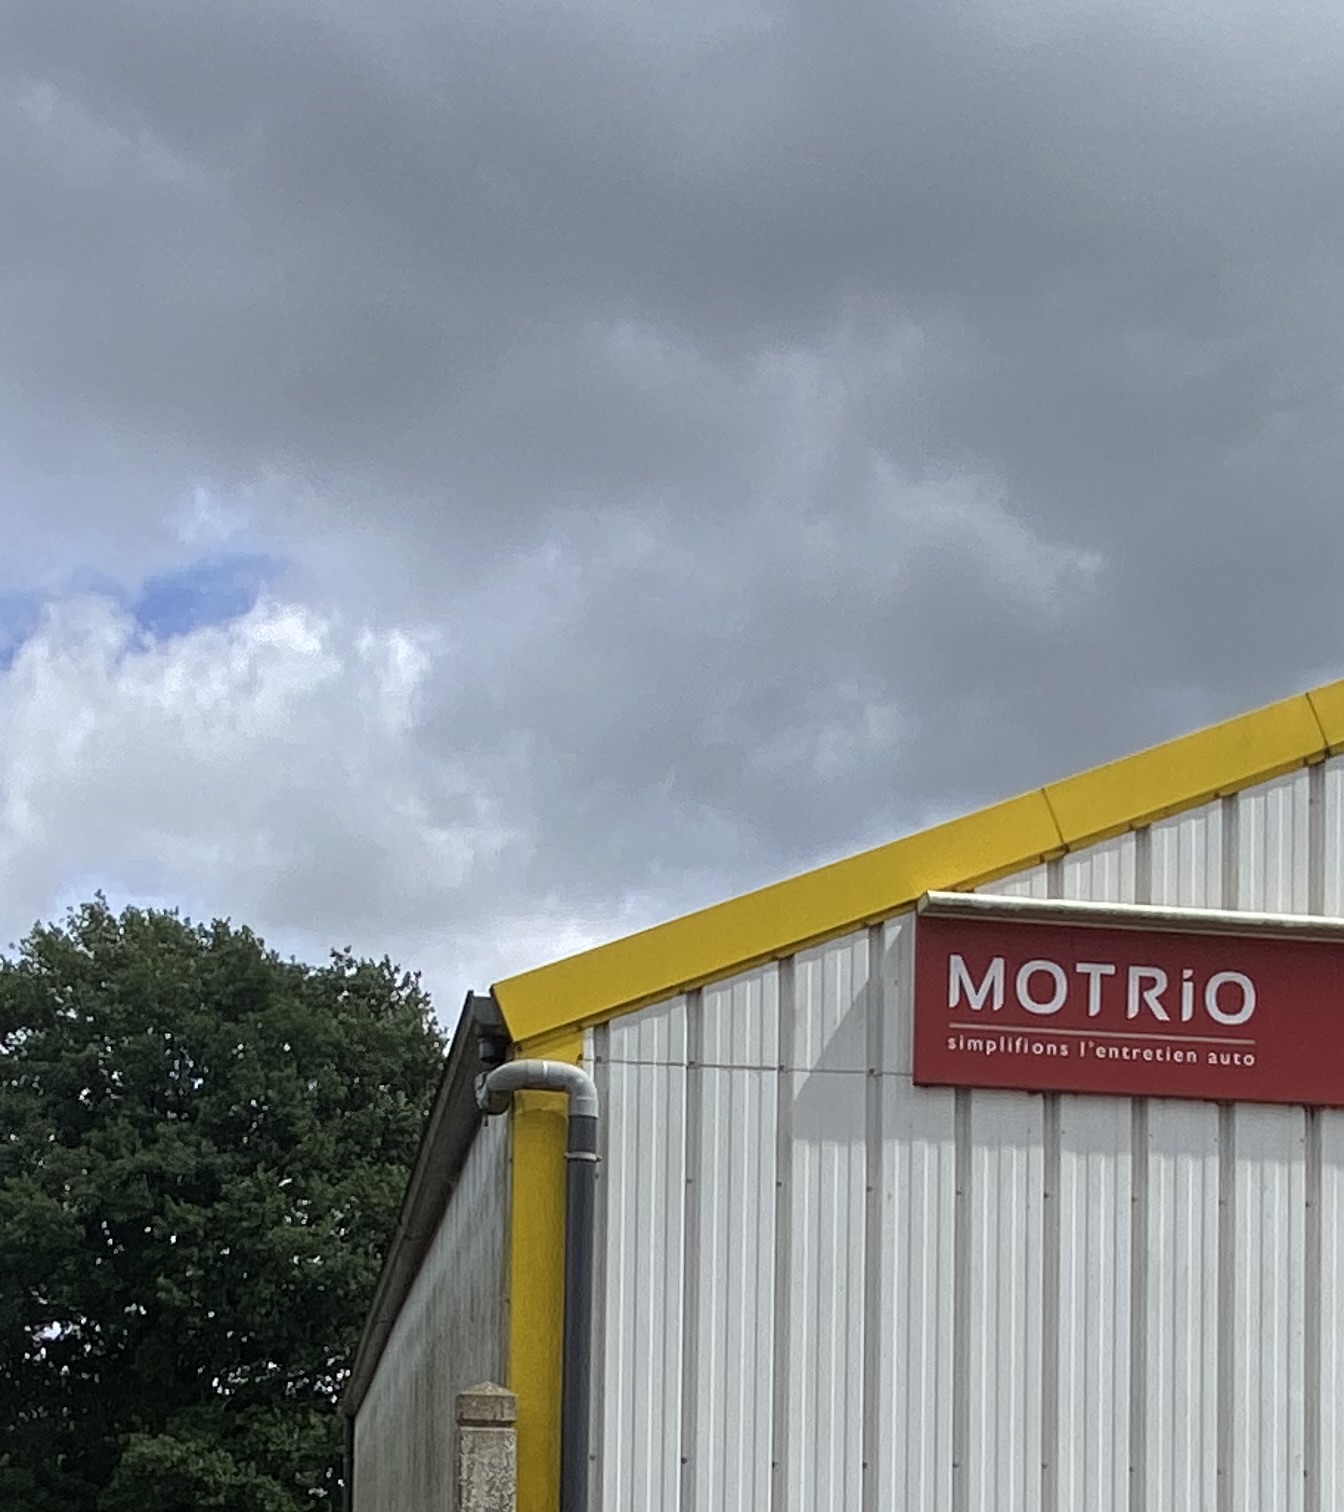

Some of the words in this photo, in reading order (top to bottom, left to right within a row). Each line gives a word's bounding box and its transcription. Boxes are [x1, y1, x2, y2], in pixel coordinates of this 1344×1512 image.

[947, 1035, 1069, 1057] simplifions
[1079, 1041, 1198, 1064] l'entretien
[1207, 1051, 1256, 1067] auto
